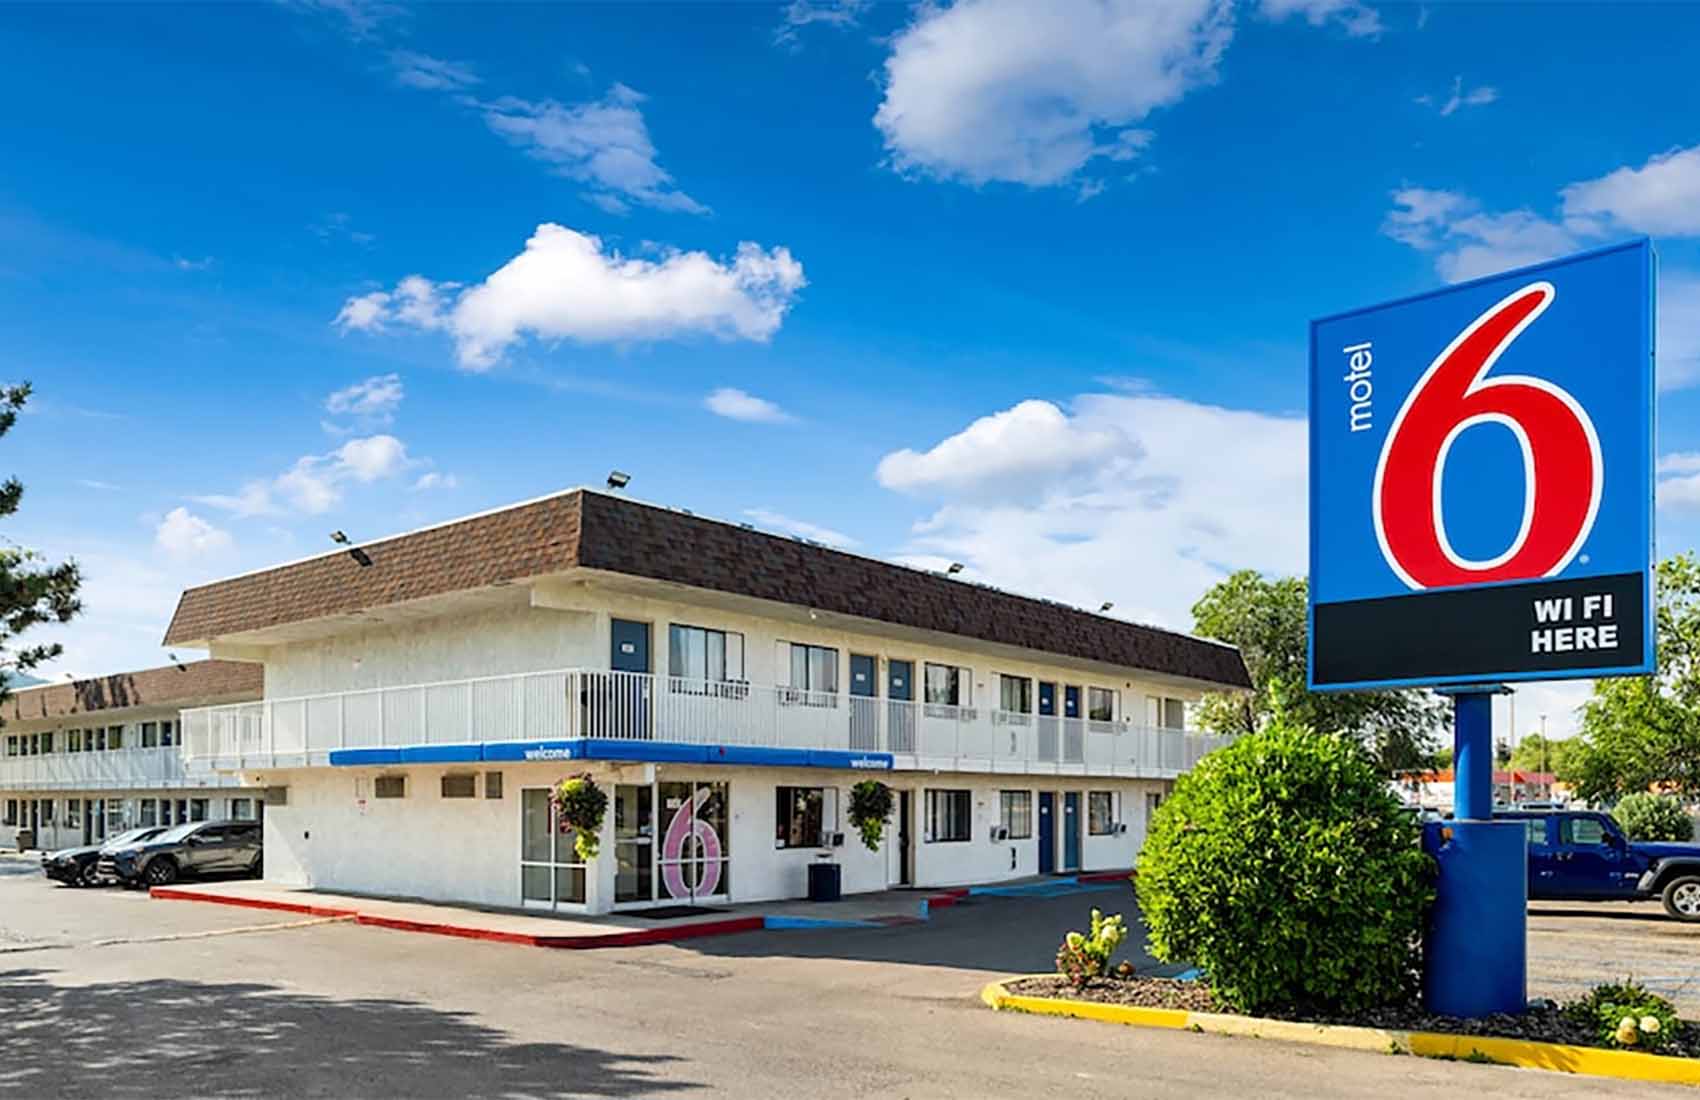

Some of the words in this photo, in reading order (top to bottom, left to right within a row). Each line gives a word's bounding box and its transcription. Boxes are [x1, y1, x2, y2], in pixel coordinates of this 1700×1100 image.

[1344, 343, 1372, 432] motel
[1372, 281, 1604, 591] 6
[1534, 597, 1573, 624] WI
[1583, 593, 1613, 619] FI
[1531, 624, 1618, 653] HERE
[524, 744, 572, 761] welcome
[849, 755, 889, 769] welcome
[663, 788, 721, 898] 6
